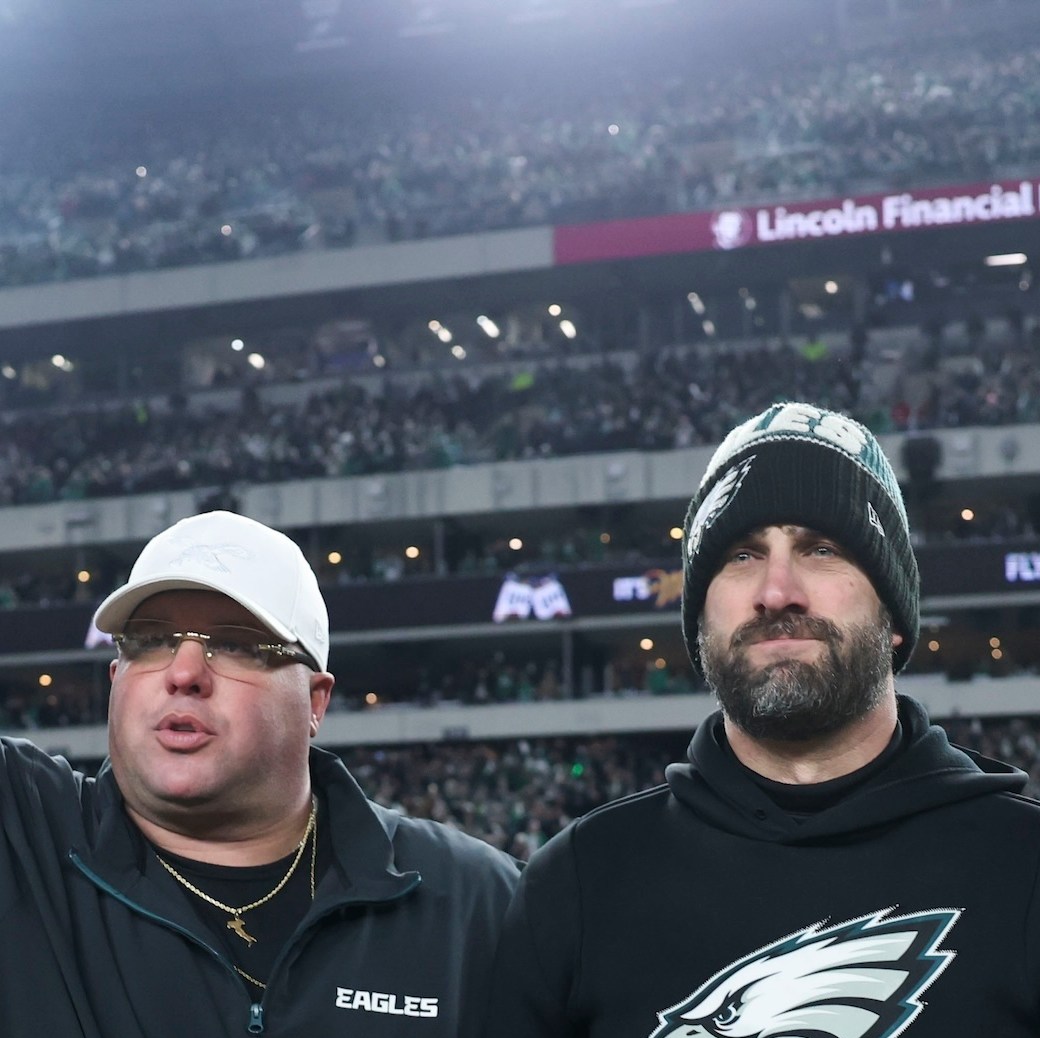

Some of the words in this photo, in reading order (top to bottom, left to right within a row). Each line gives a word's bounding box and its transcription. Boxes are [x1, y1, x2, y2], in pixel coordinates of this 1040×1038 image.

[756, 199, 878, 242] Lincoln
[882, 182, 1034, 229] Financial
[335, 986, 439, 1018] EAGLES
